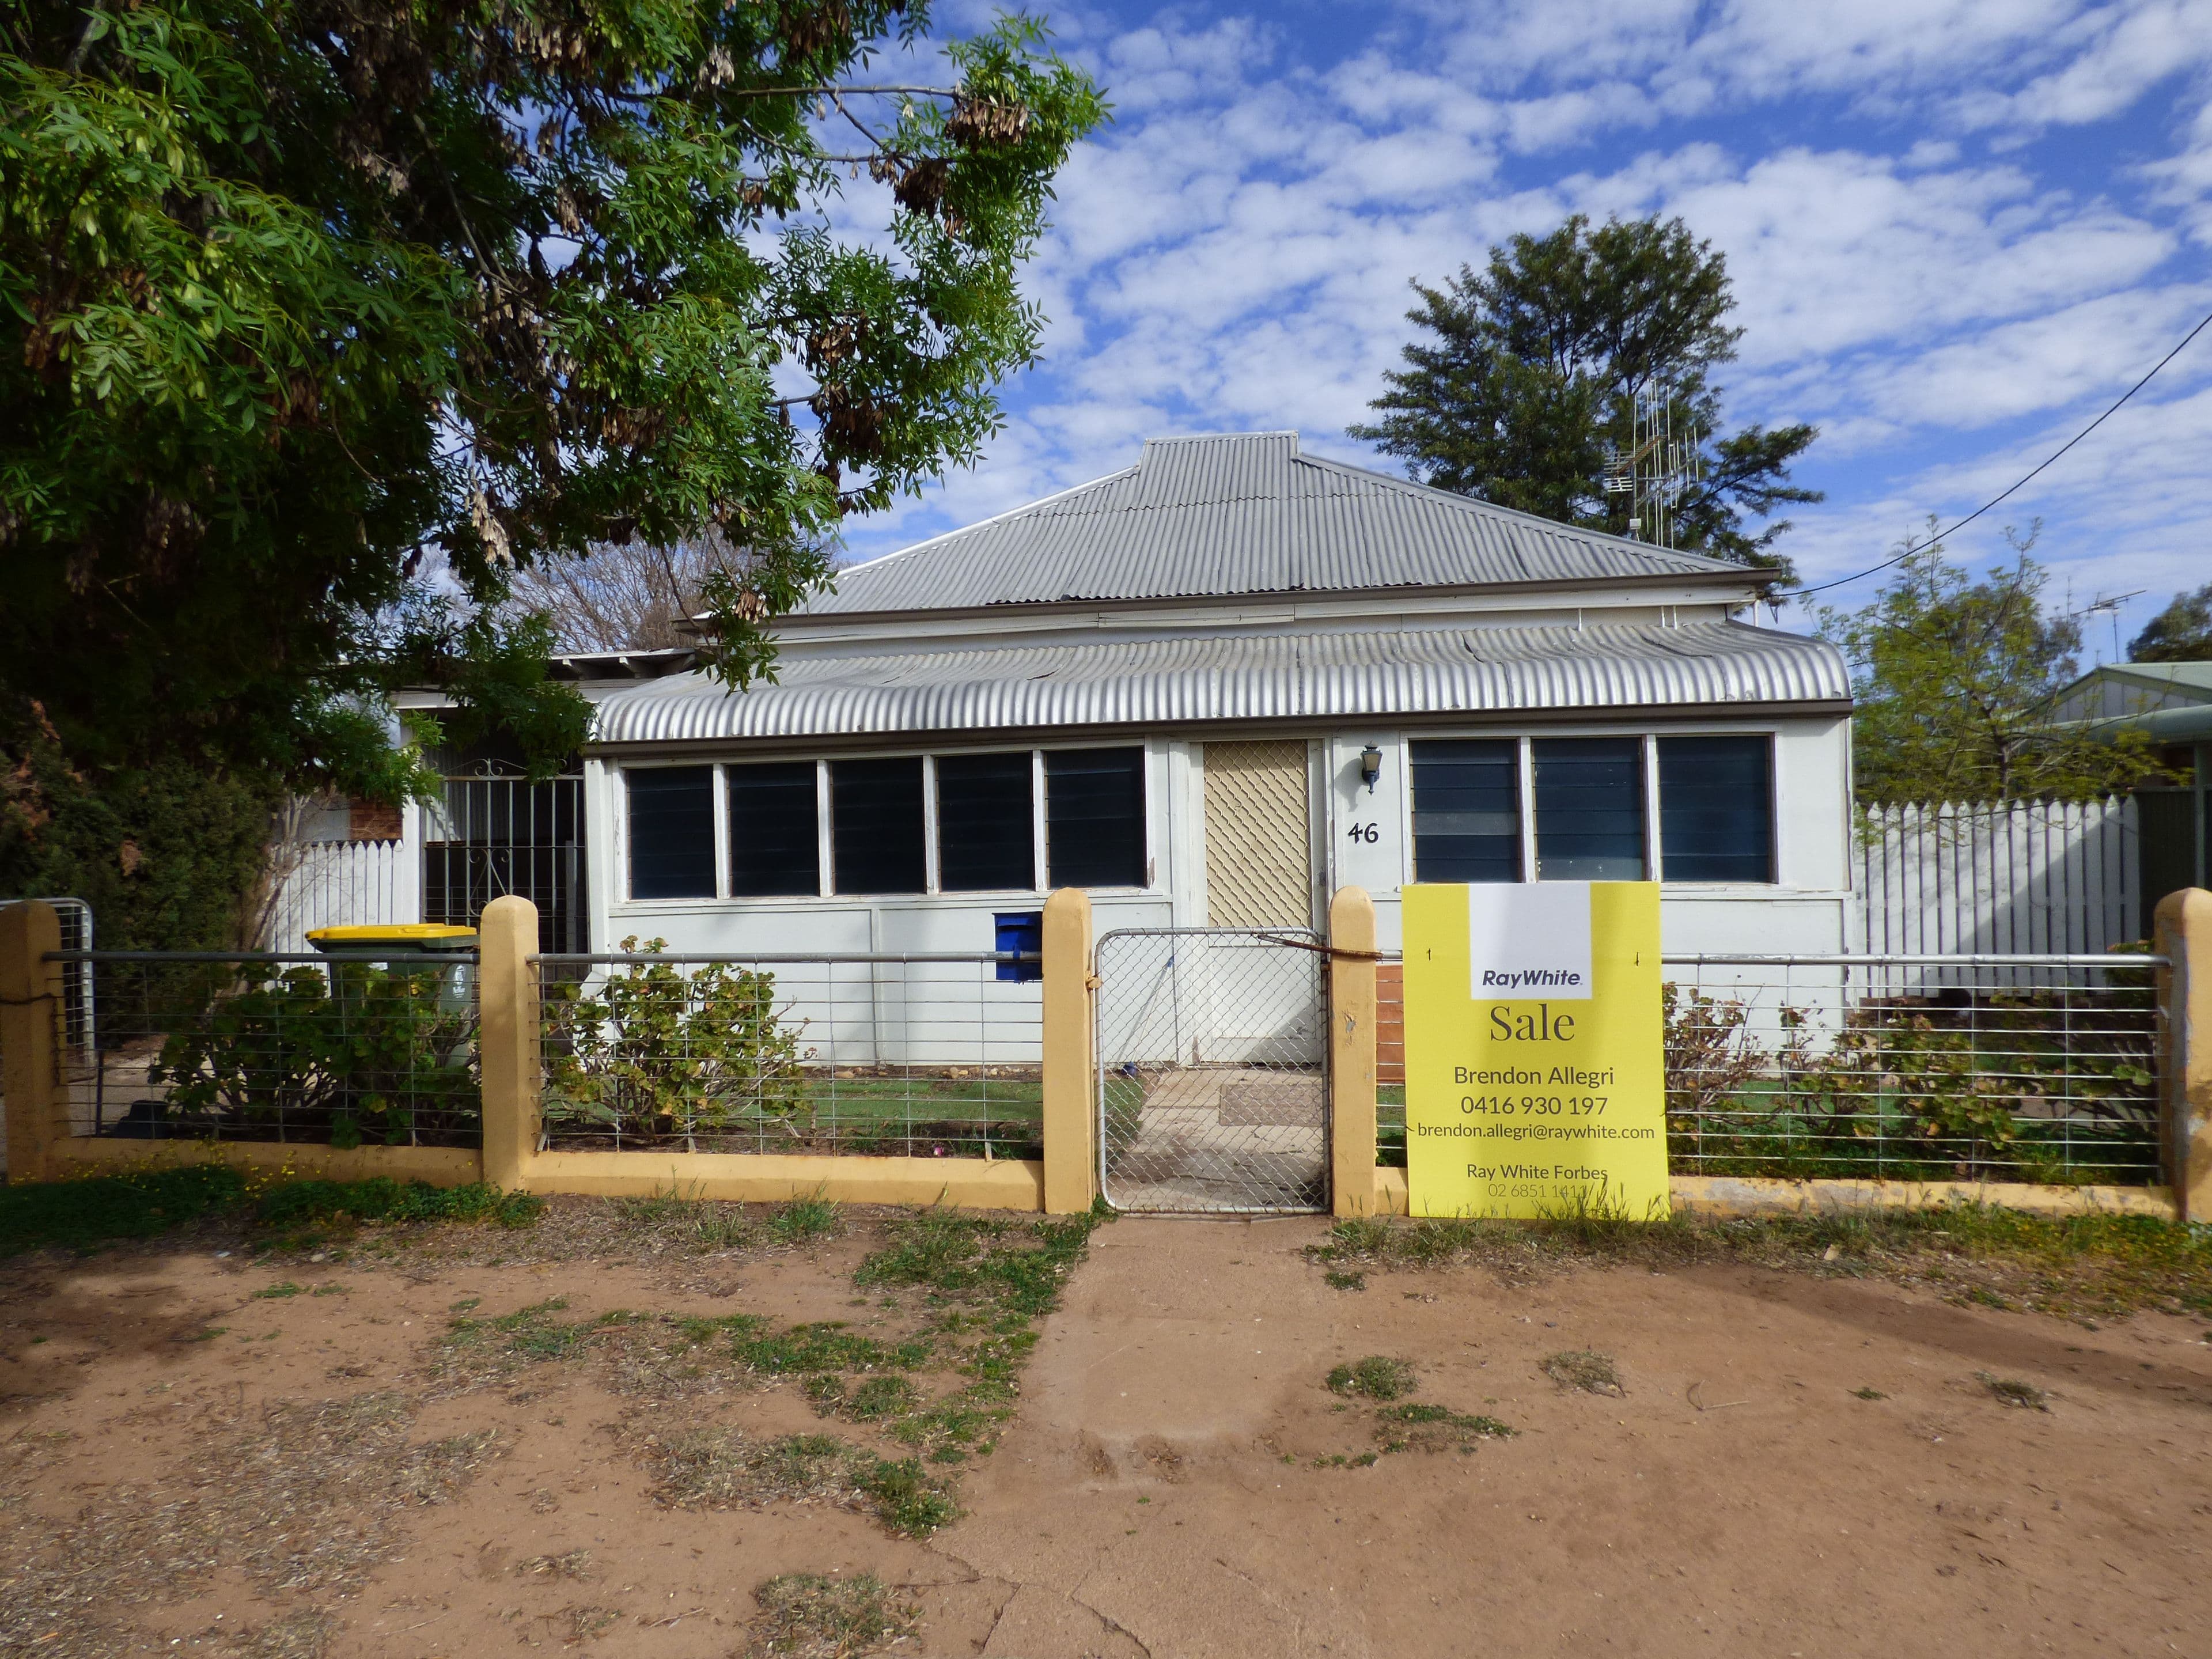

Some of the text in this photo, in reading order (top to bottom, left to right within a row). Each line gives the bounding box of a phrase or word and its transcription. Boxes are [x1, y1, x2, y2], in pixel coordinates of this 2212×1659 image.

[1348, 823, 1379, 844] 46
[1482, 969, 1581, 989] RayWhite
[1490, 1003, 1575, 1041] Sale
[1455, 1066, 1614, 1088] Brendon Allegri
[1461, 1096, 1608, 1115] 0416 930 197
[1418, 1123, 1655, 1141] brendon.allegri@raywhite.com
[1467, 1164, 1608, 1181] Ray White Forbes
[1488, 1183, 1506, 1198] 02
[1511, 1184, 1547, 1198] 6851
